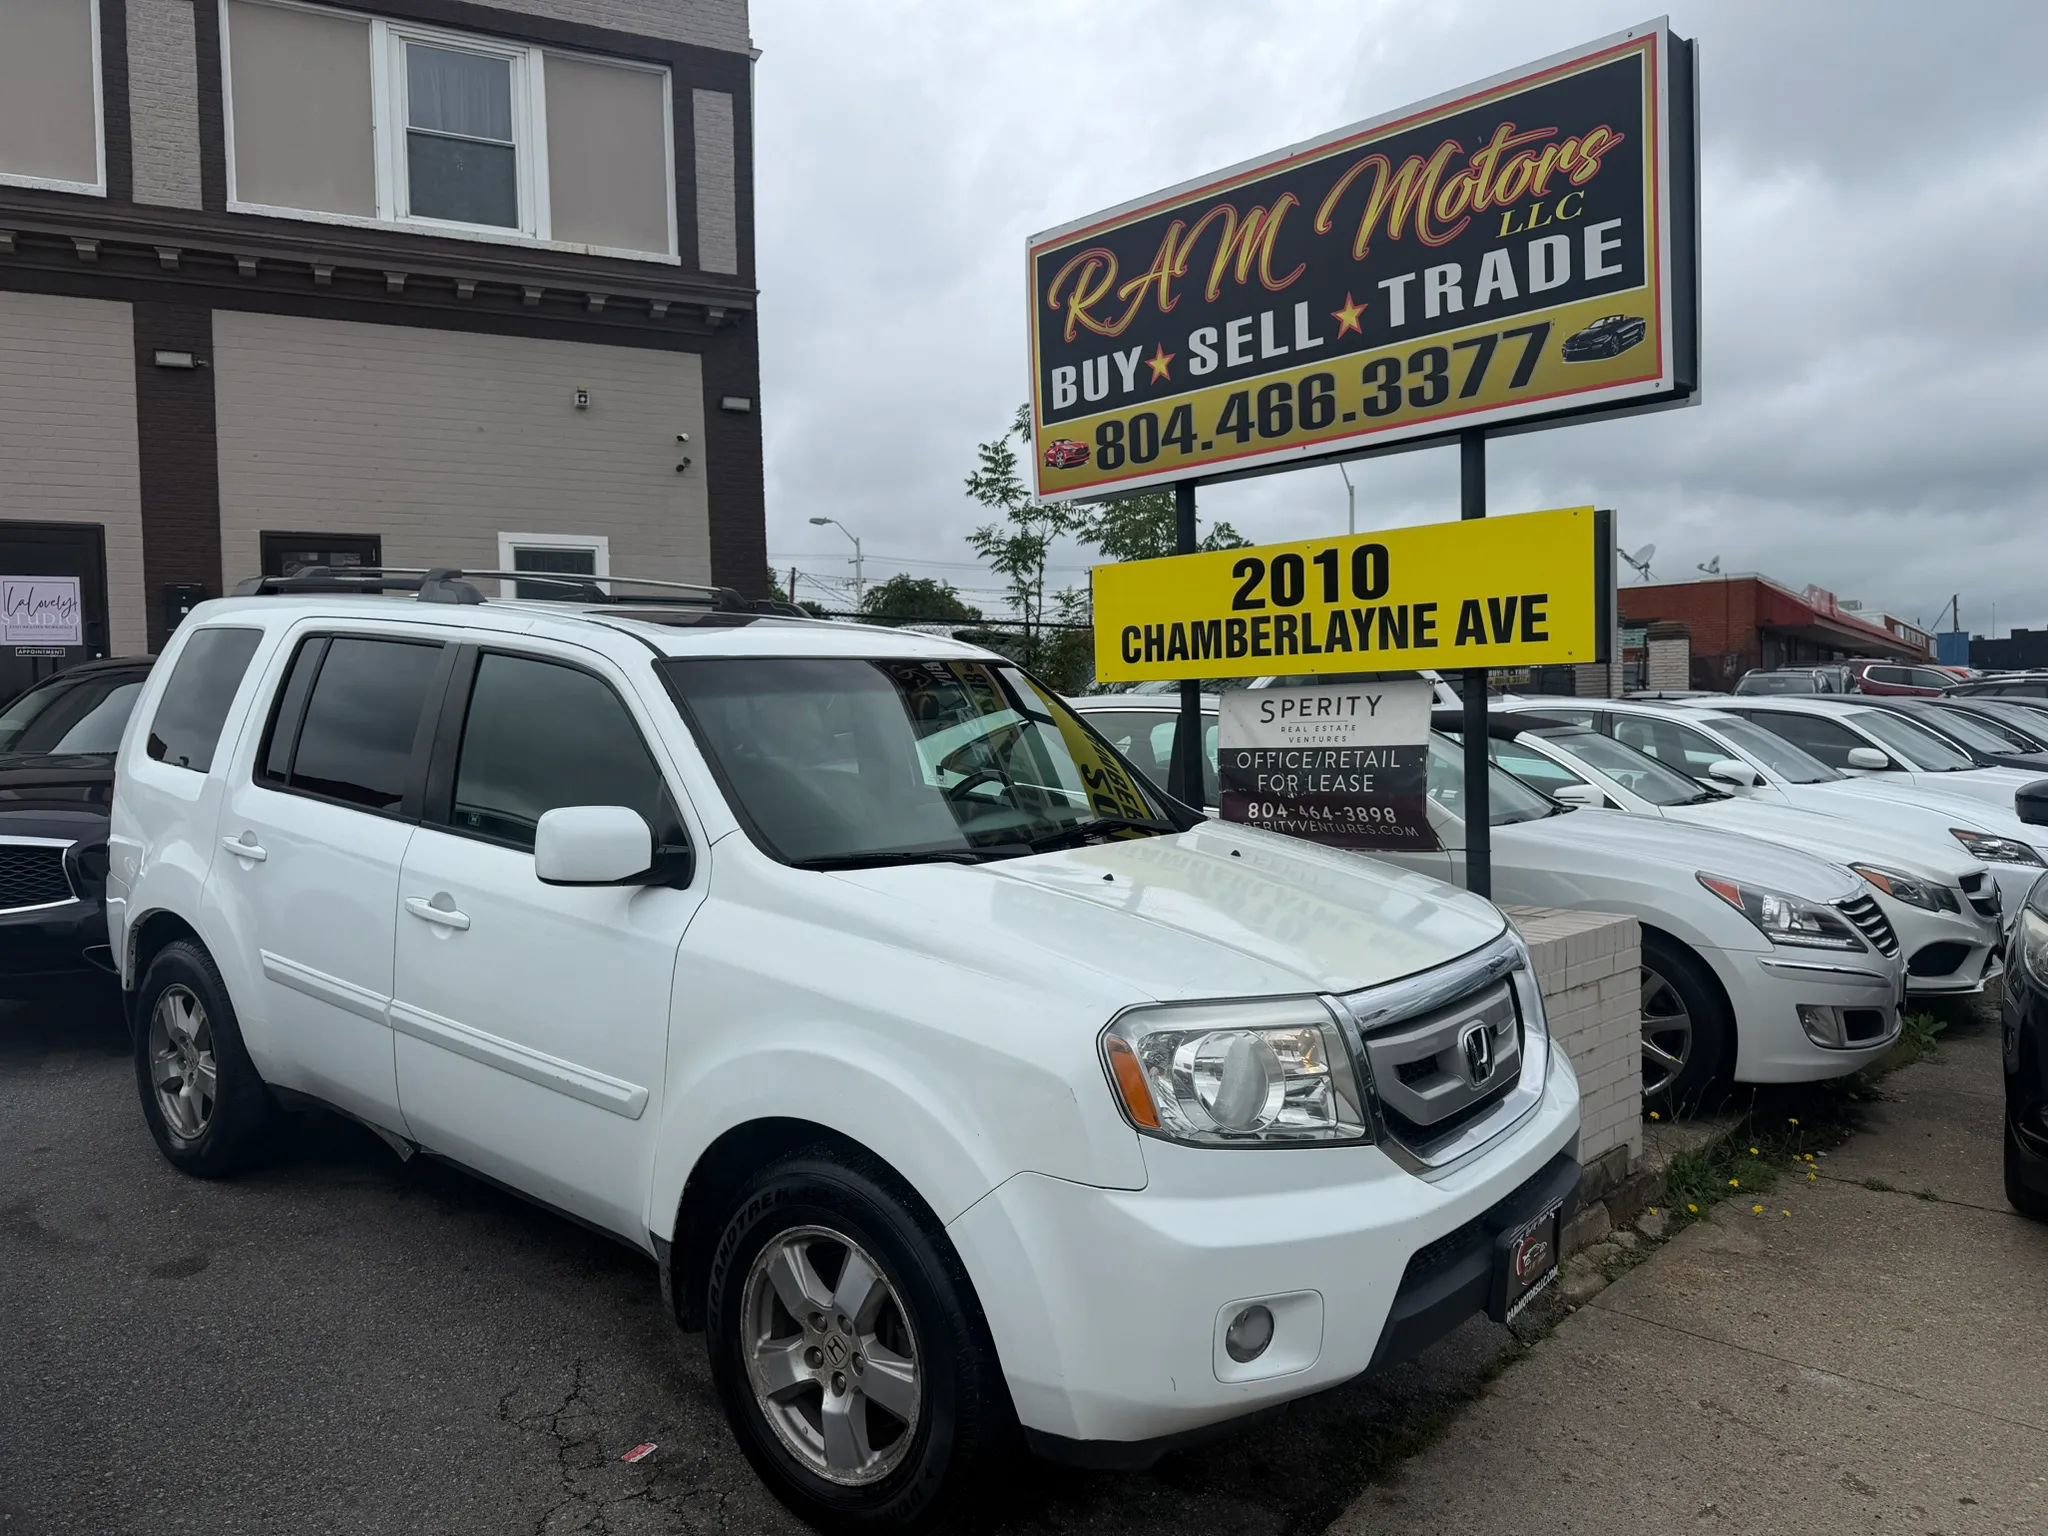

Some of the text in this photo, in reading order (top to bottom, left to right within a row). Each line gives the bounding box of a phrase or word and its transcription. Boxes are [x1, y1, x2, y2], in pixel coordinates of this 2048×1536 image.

[1047, 121, 1625, 343] RAM Motors
[1496, 189, 1585, 239] LLC
[1051, 217, 1624, 411] BUY SELL TRADE
[1094, 319, 1552, 472] 804.466.3377
[1231, 543, 1390, 611] 2010
[1120, 593, 1549, 664] CHAMBERLAYNE AVE
[1260, 694, 1383, 724] SPERITY
[1280, 724, 1357, 733] REAL ESTATE
[1236, 750, 1401, 769] OFFICE/RETAIL
[1288, 735, 1347, 744] VENTURES
[1257, 774, 1375, 793] FOR LEASE
[1247, 802, 1397, 824] 804-464-3898
